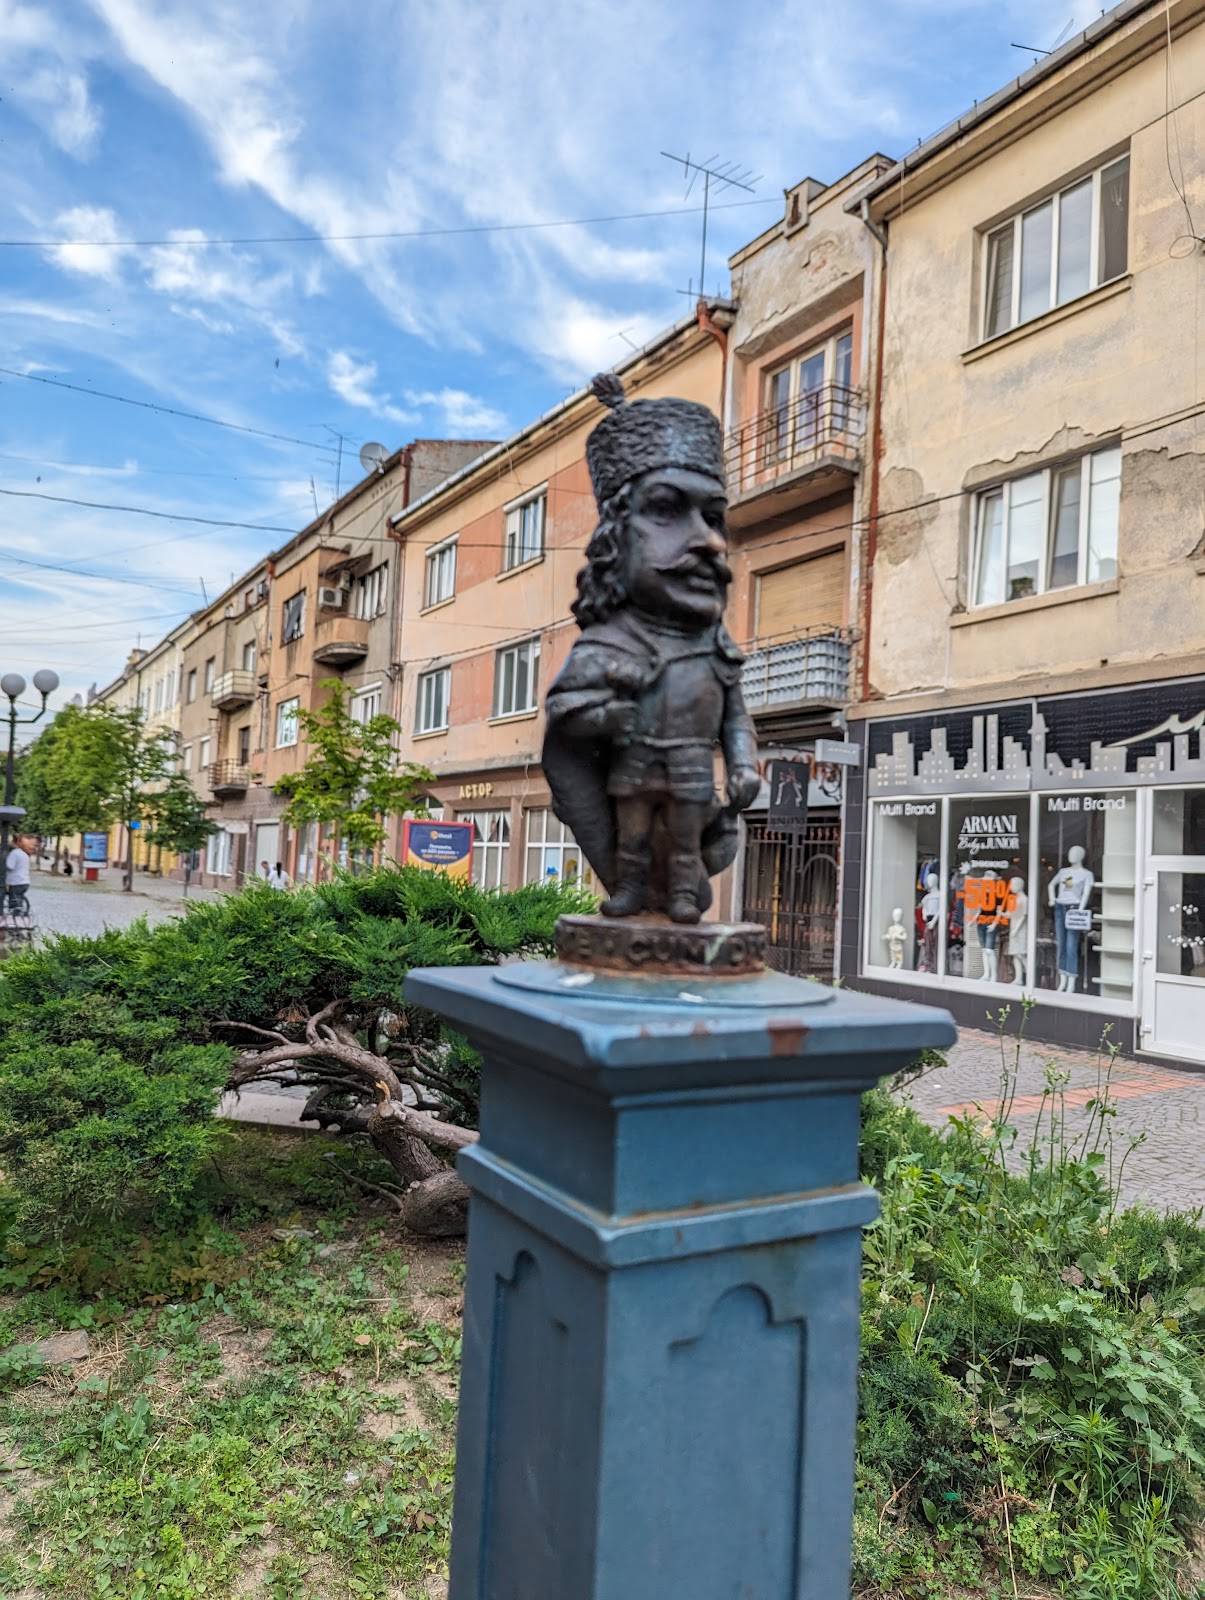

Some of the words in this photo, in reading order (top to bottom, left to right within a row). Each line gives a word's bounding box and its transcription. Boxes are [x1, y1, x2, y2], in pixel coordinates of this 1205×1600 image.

[459, 782, 492, 798] АСТОР
[880, 804, 903, 816] Multi
[904, 802, 936, 816] Brand
[1047, 797, 1080, 812] Multi
[1083, 795, 1126, 811] Brand
[961, 815, 1017, 833] ARMANI
[956, 879, 1017, 912] -50%
